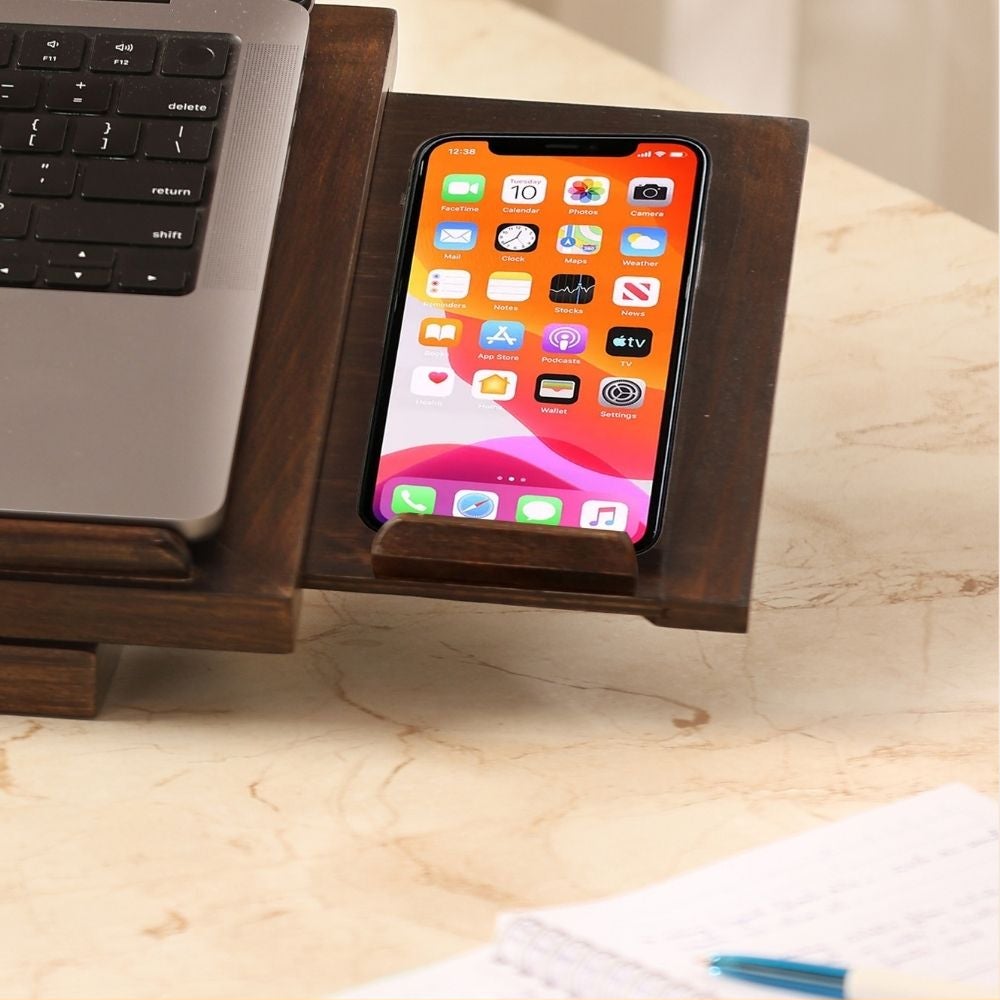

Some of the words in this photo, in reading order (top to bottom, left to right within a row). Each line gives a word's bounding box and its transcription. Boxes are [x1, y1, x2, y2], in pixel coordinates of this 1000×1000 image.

[76, 81, 86, 89] +
[168, 102, 207, 112] delete
[32, 119, 40, 131] {
[104, 122, 111, 134] }
[29, 135, 36, 146] [
[101, 138, 108, 149] ]
[175, 141, 180, 153] \
[152, 187, 191, 196] return
[511, 184, 537, 200] 10
[568, 208, 598, 216] Photos
[630, 210, 664, 218] Camera
[152, 231, 182, 240] shift
[502, 255, 525, 263] Clock
[565, 257, 587, 266] Maps
[622, 259, 658, 267] Weather
[554, 307, 583, 315] Stocks
[621, 309, 645, 317] News
[628, 336, 646, 348] tv
[477, 353, 495, 361] App
[541, 357, 581, 365] Podcasts
[541, 407, 567, 415] Wallet
[600, 411, 637, 420] Settings
